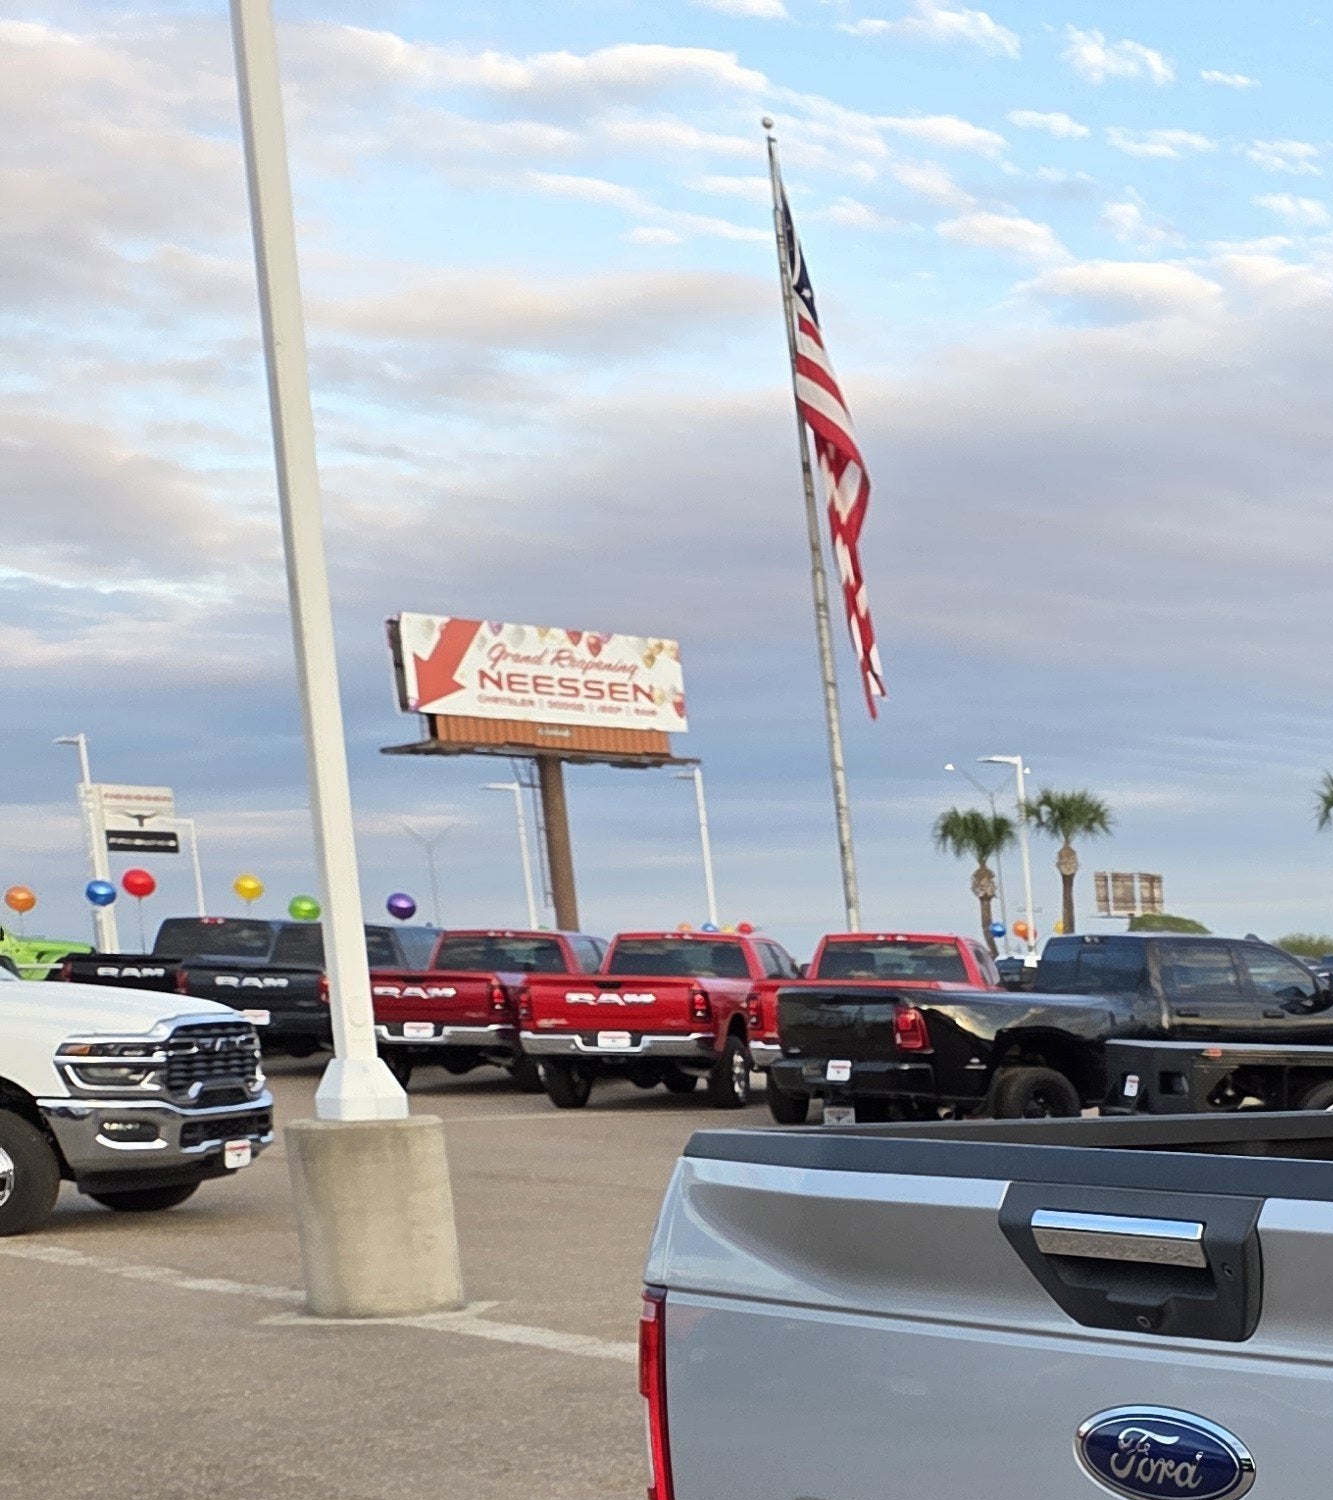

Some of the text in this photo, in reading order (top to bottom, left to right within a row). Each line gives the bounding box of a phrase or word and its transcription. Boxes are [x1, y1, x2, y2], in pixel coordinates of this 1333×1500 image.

[487, 642, 548, 670] Grand
[477, 668, 656, 703] NEESSEN
[97, 966, 165, 978] RAM
[214, 975, 289, 988] RAM
[373, 986, 457, 999] RAM
[565, 992, 656, 1005] RAM
[1110, 1427, 1203, 1488] Ford
